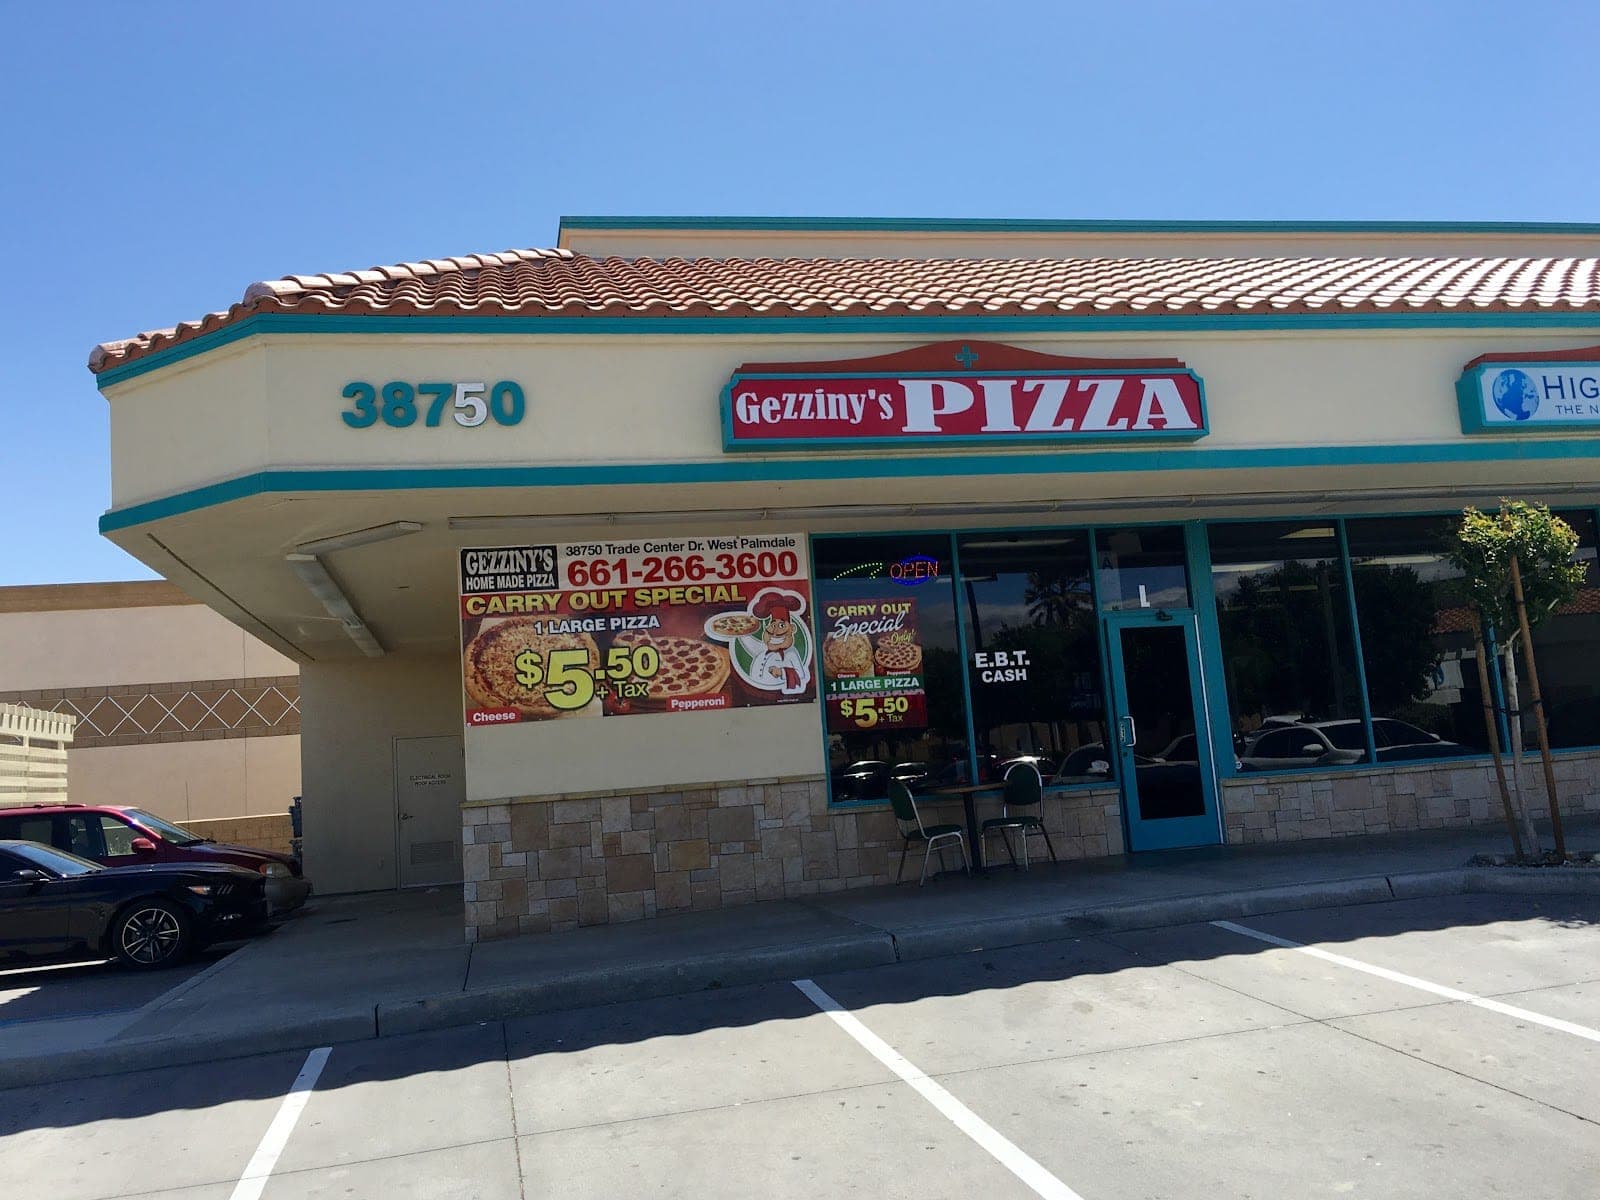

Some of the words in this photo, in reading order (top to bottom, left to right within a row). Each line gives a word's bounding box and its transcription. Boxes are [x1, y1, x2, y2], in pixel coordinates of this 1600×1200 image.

[341, 380, 525, 428] 38750
[735, 388, 893, 424] Gezziny's
[898, 378, 1197, 432] PIZZA
[1555, 404, 1584, 414] THE
[566, 544, 602, 556] 38750
[606, 543, 640, 554] Trade
[643, 541, 685, 553] Center
[688, 540, 705, 551] Dr.
[708, 538, 738, 550] West
[741, 536, 796, 549] Palmdale
[465, 548, 554, 575] GEZZINY'S
[567, 550, 798, 588] 661-266-3600
[890, 561, 938, 579] OPEN
[466, 576, 495, 590] HOME
[497, 575, 528, 588] MADE
[527, 573, 555, 587] PIZZA
[466, 592, 561, 616] CARRY
[569, 590, 627, 610] OUT
[634, 585, 747, 607] SPECIAL
[1139, 584, 1151, 608] L
[827, 604, 876, 617] CARRY
[881, 602, 911, 614] OUT
[534, 623, 543, 635] 1
[549, 618, 605, 633] LARGE
[610, 615, 661, 630] PIZZA
[832, 610, 907, 642] Special
[975, 650, 1030, 668] E.B.T.
[831, 682, 837, 691] 1
[841, 679, 880, 690] LARGE
[884, 677, 919, 688] PIZZA
[982, 668, 1027, 683] CASH
[671, 696, 725, 709] Pepperoni
[473, 711, 516, 722] Cheese
